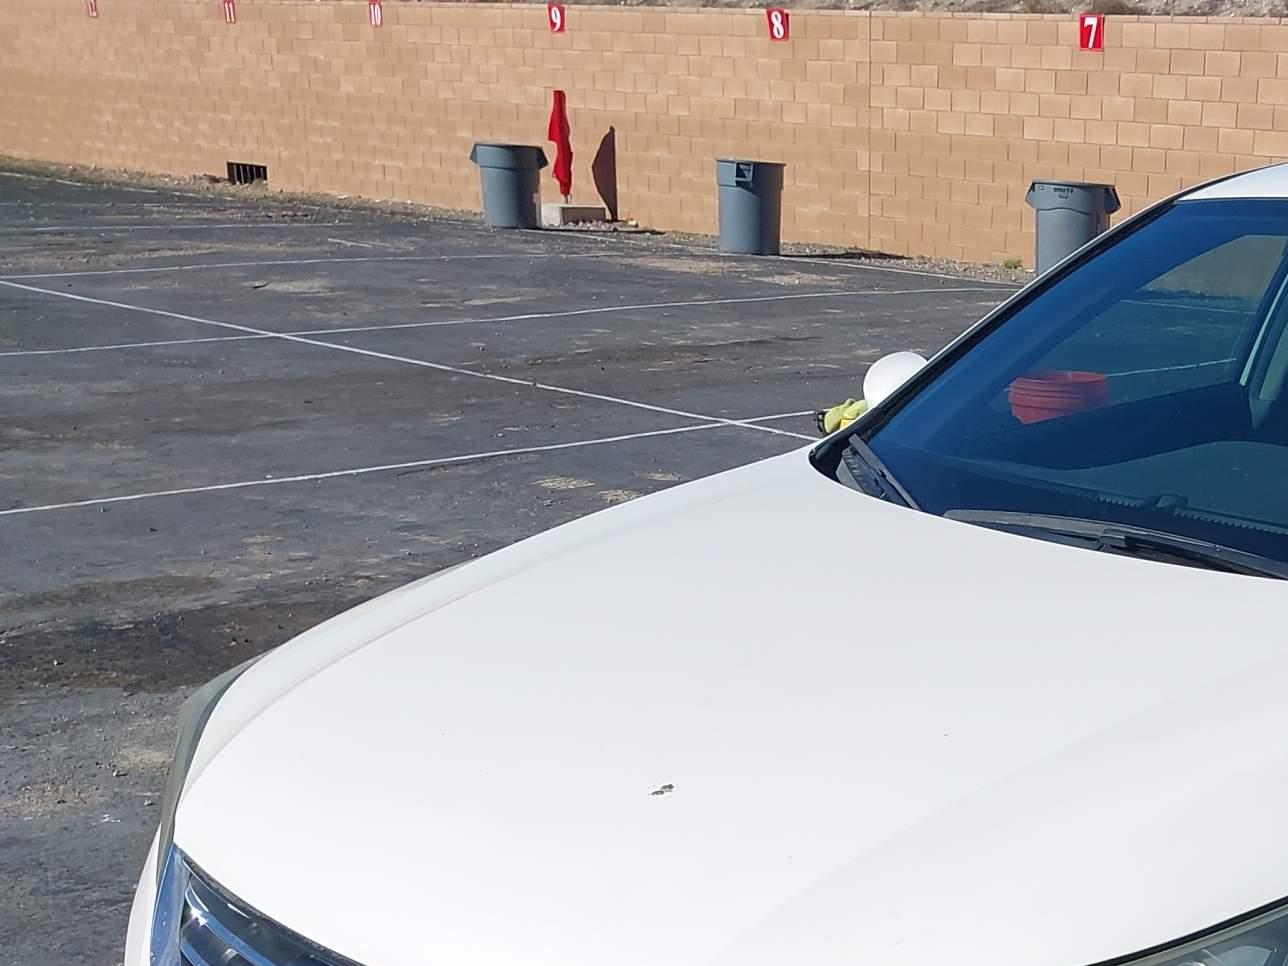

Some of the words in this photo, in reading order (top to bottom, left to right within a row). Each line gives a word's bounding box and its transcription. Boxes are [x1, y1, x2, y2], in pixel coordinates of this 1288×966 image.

[225, 2, 235, 22] 11
[370, 4, 381, 26] 10
[551, 6, 561, 31] 9
[771, 11, 784, 38] 8
[1084, 16, 1098, 49] 7
